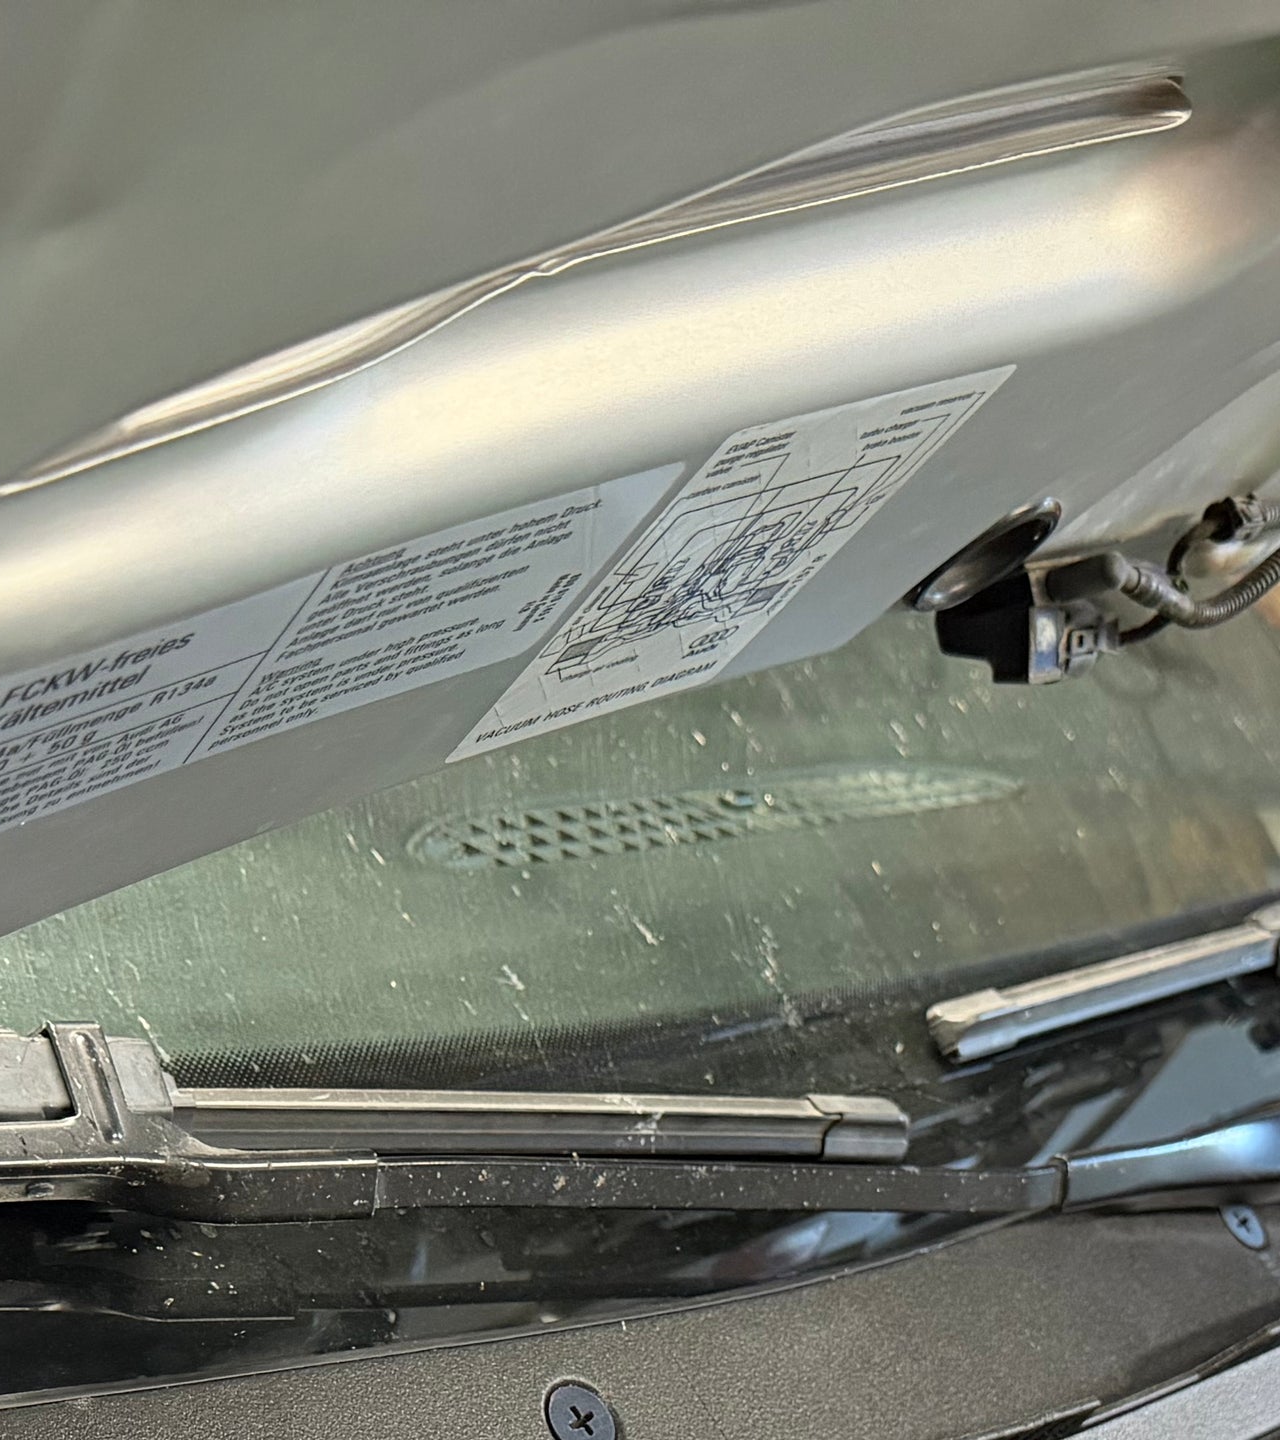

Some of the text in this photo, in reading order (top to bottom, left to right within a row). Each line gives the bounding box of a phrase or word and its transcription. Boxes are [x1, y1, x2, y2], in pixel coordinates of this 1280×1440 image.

[355, 547, 481, 592] Verschraubungen
[533, 519, 571, 537] nicht
[424, 539, 465, 560] steht
[508, 512, 558, 533] hohem
[438, 553, 495, 577] solange
[497, 545, 521, 559] die
[522, 530, 572, 551] Anlage
[275, 621, 377, 662] Fachpersonal
[376, 600, 444, 630] gewartet
[285, 624, 340, 648] Anlage
[342, 610, 376, 629] darf
[375, 603, 403, 619] nur
[295, 614, 338, 635] unter
[340, 598, 386, 619] Druck
[237, 618, 506, 711] Do not open parts and fittings as long
[247, 679, 279, 697] A/C
[280, 662, 335, 686] system
[338, 647, 382, 667] under
[382, 636, 415, 653] high
[149, 675, 218, 707] R134a
[218, 648, 465, 736] System to be serviced by qualified
[228, 711, 248, 723] as
[250, 702, 276, 716] the
[279, 683, 333, 706] system
[335, 677, 351, 688] is
[353, 662, 395, 682] under
[475, 660, 717, 743] VACUUM HOSE ROUTING DIAGRAM
[45, 735, 79, 756] 50
[116, 724, 155, 744] Audi
[157, 712, 185, 729] AG
[207, 707, 318, 750] personnel only.
[100, 750, 133, 769] 250
[135, 738, 169, 756] ccm
[25, 779, 82, 805] Details
[86, 763, 123, 783] sind
[124, 754, 152, 770] der
[41, 796, 61, 809] zu
[65, 759, 160, 800] entnehmen!
